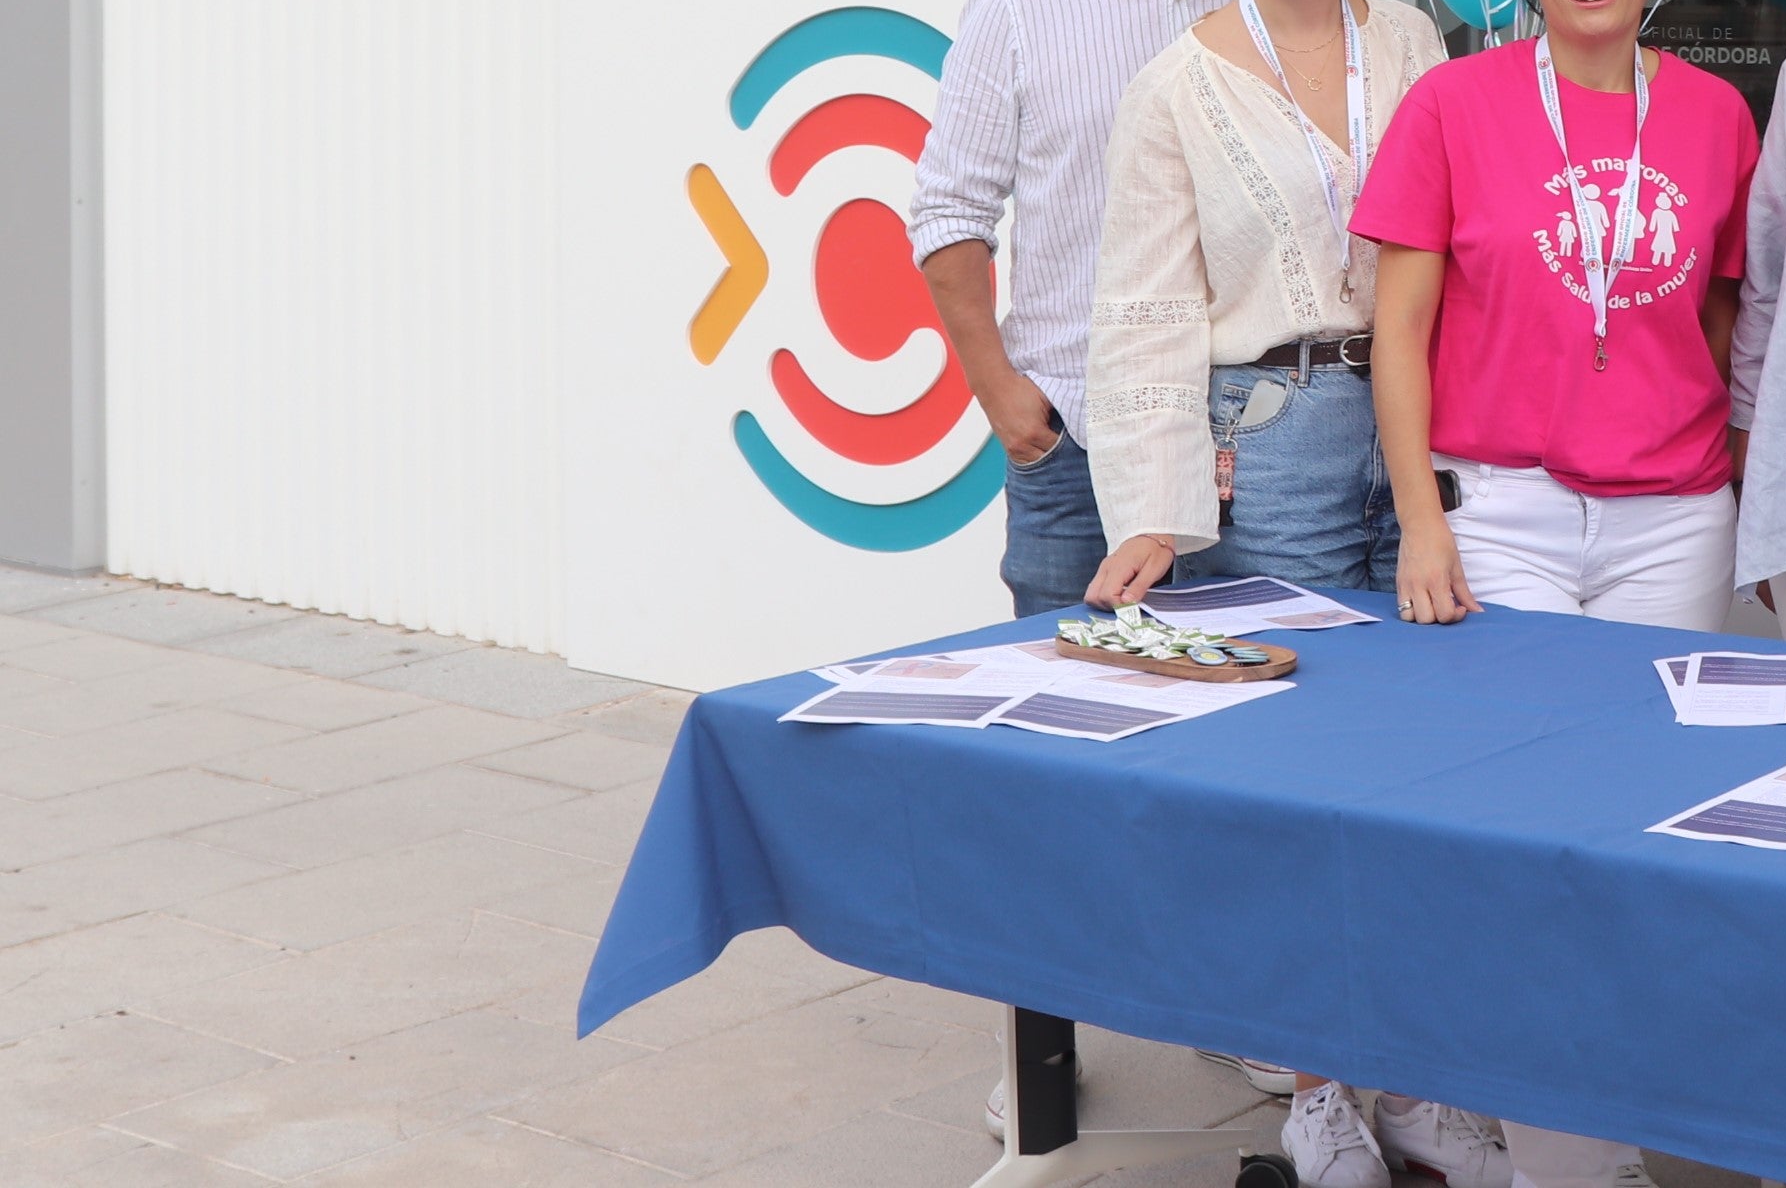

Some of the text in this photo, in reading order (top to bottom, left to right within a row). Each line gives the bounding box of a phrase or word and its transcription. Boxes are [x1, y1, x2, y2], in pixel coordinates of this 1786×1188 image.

[1713, 27, 1733, 40] DE
[1678, 41, 1771, 64] CÓRDOBA
[1533, 229, 1698, 309] Más salu de la mujer
